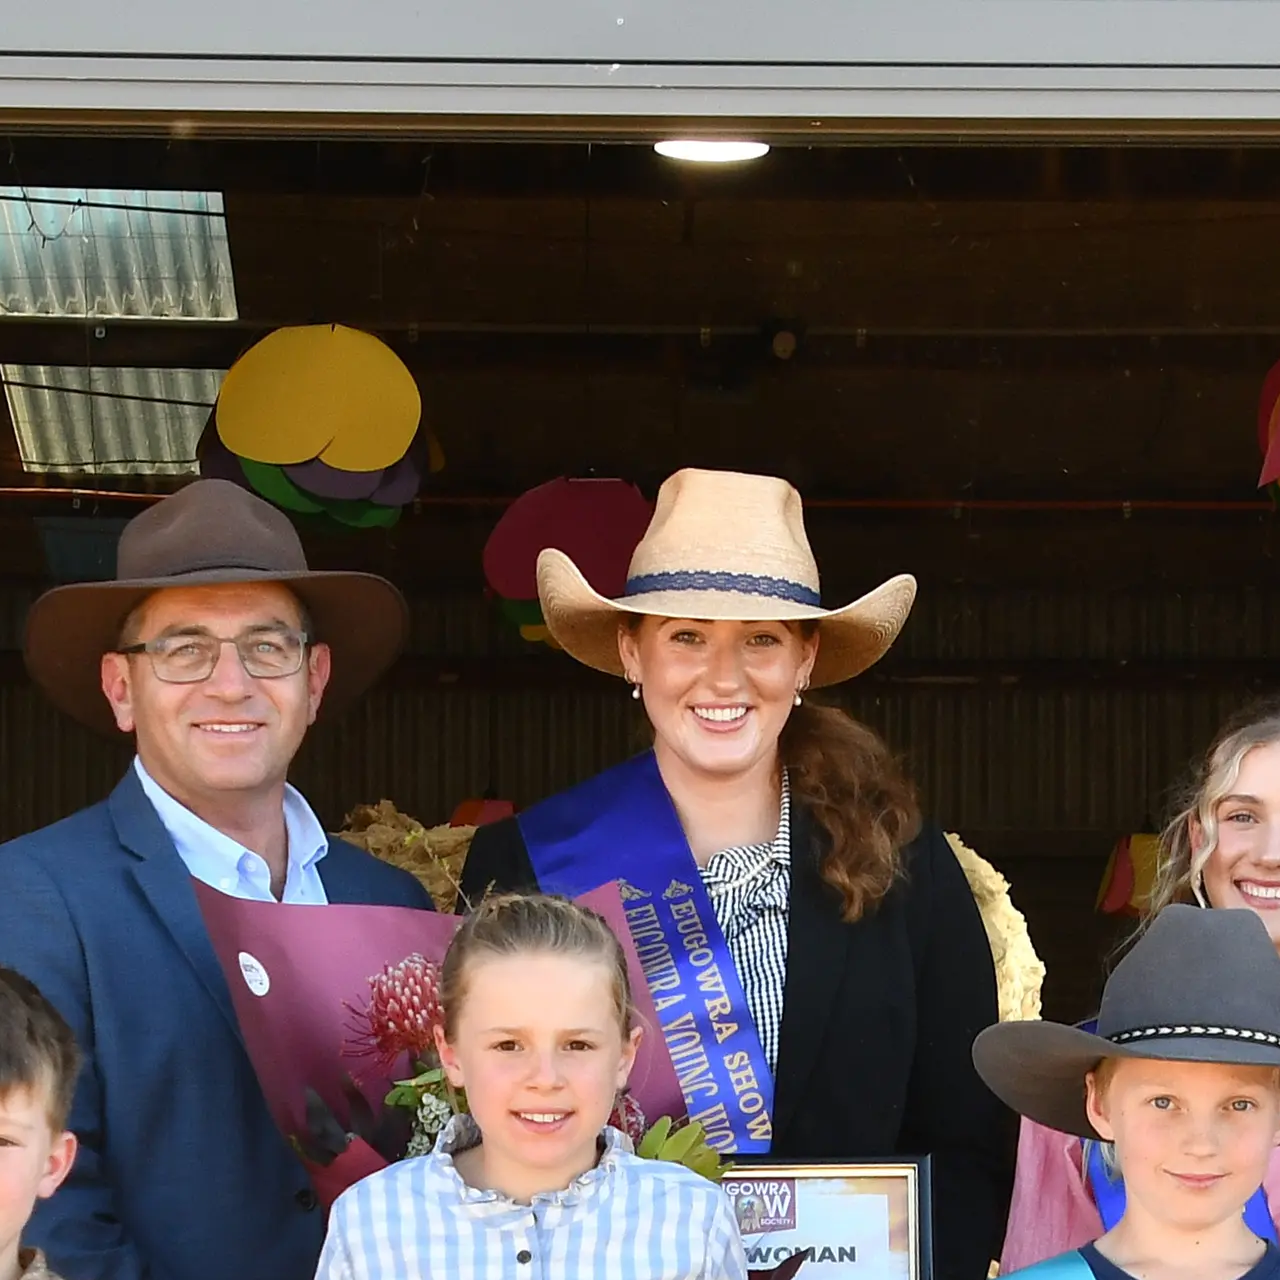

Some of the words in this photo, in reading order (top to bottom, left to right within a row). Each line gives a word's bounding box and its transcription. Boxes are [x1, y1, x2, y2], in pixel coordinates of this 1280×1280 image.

[663, 1011, 719, 1105] YOUNG
[670, 898, 740, 1045] EUGOWRA
[723, 1050, 773, 1141] SHOW
[722, 1182, 791, 1196] GOWRA
